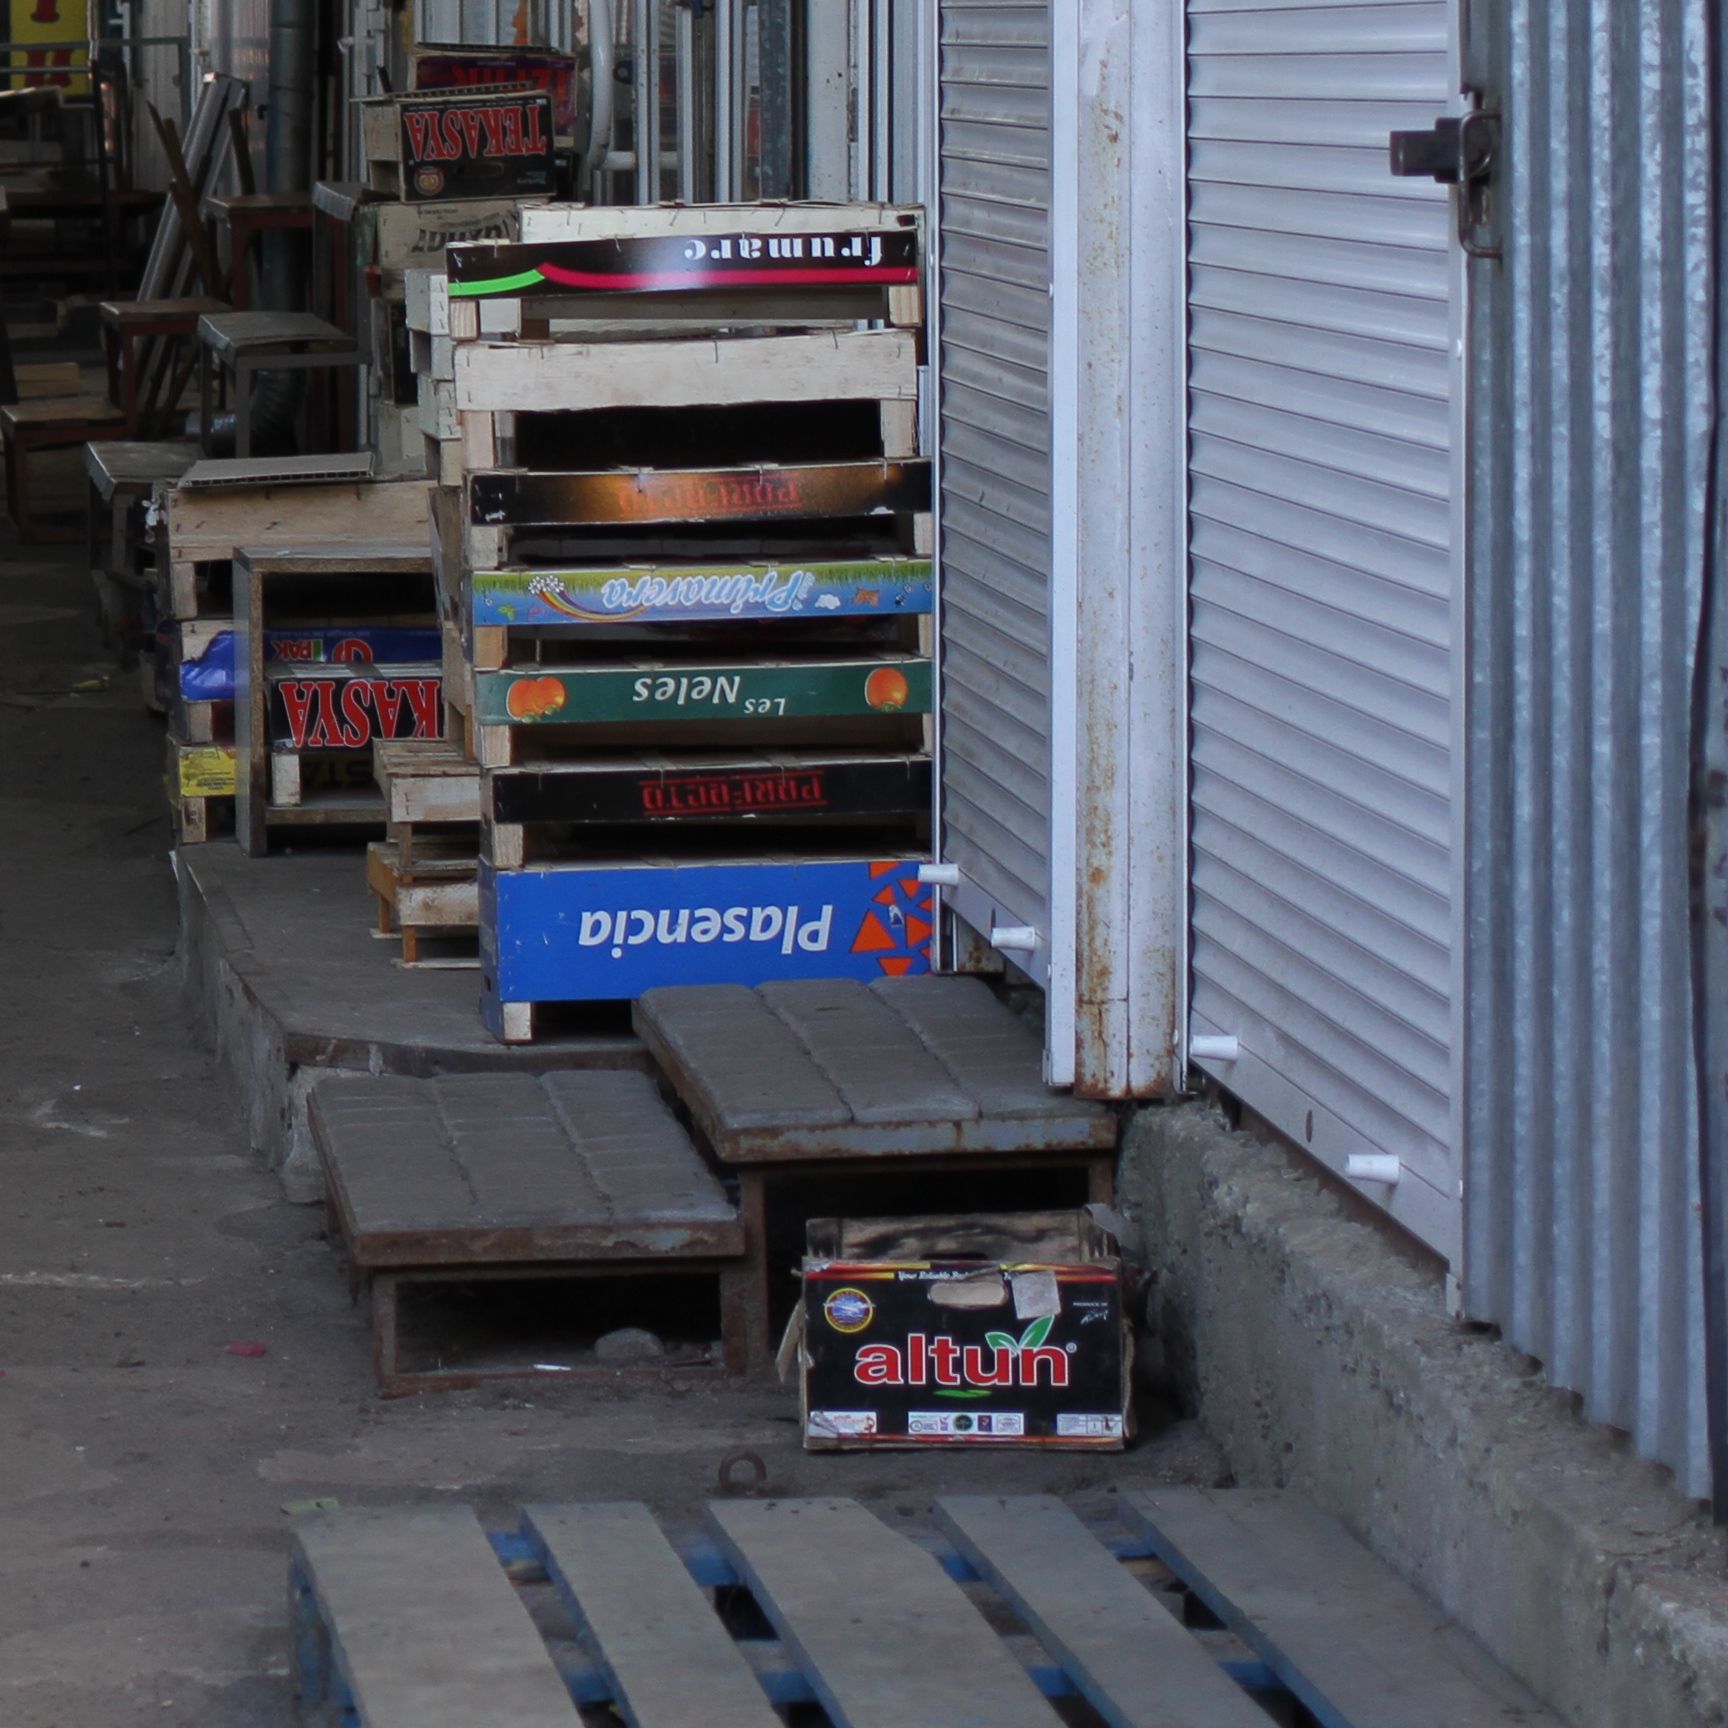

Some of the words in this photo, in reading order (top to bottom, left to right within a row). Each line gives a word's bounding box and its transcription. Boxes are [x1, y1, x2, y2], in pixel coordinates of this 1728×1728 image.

[403, 104, 548, 162] TEKASYA
[683, 236, 883, 267] frumarc
[600, 571, 805, 614] Primavera
[632, 675, 741, 706] Neles
[743, 697, 786, 717] Les
[578, 903, 834, 959] Plasencia
[853, 1332, 1069, 1387] altun
